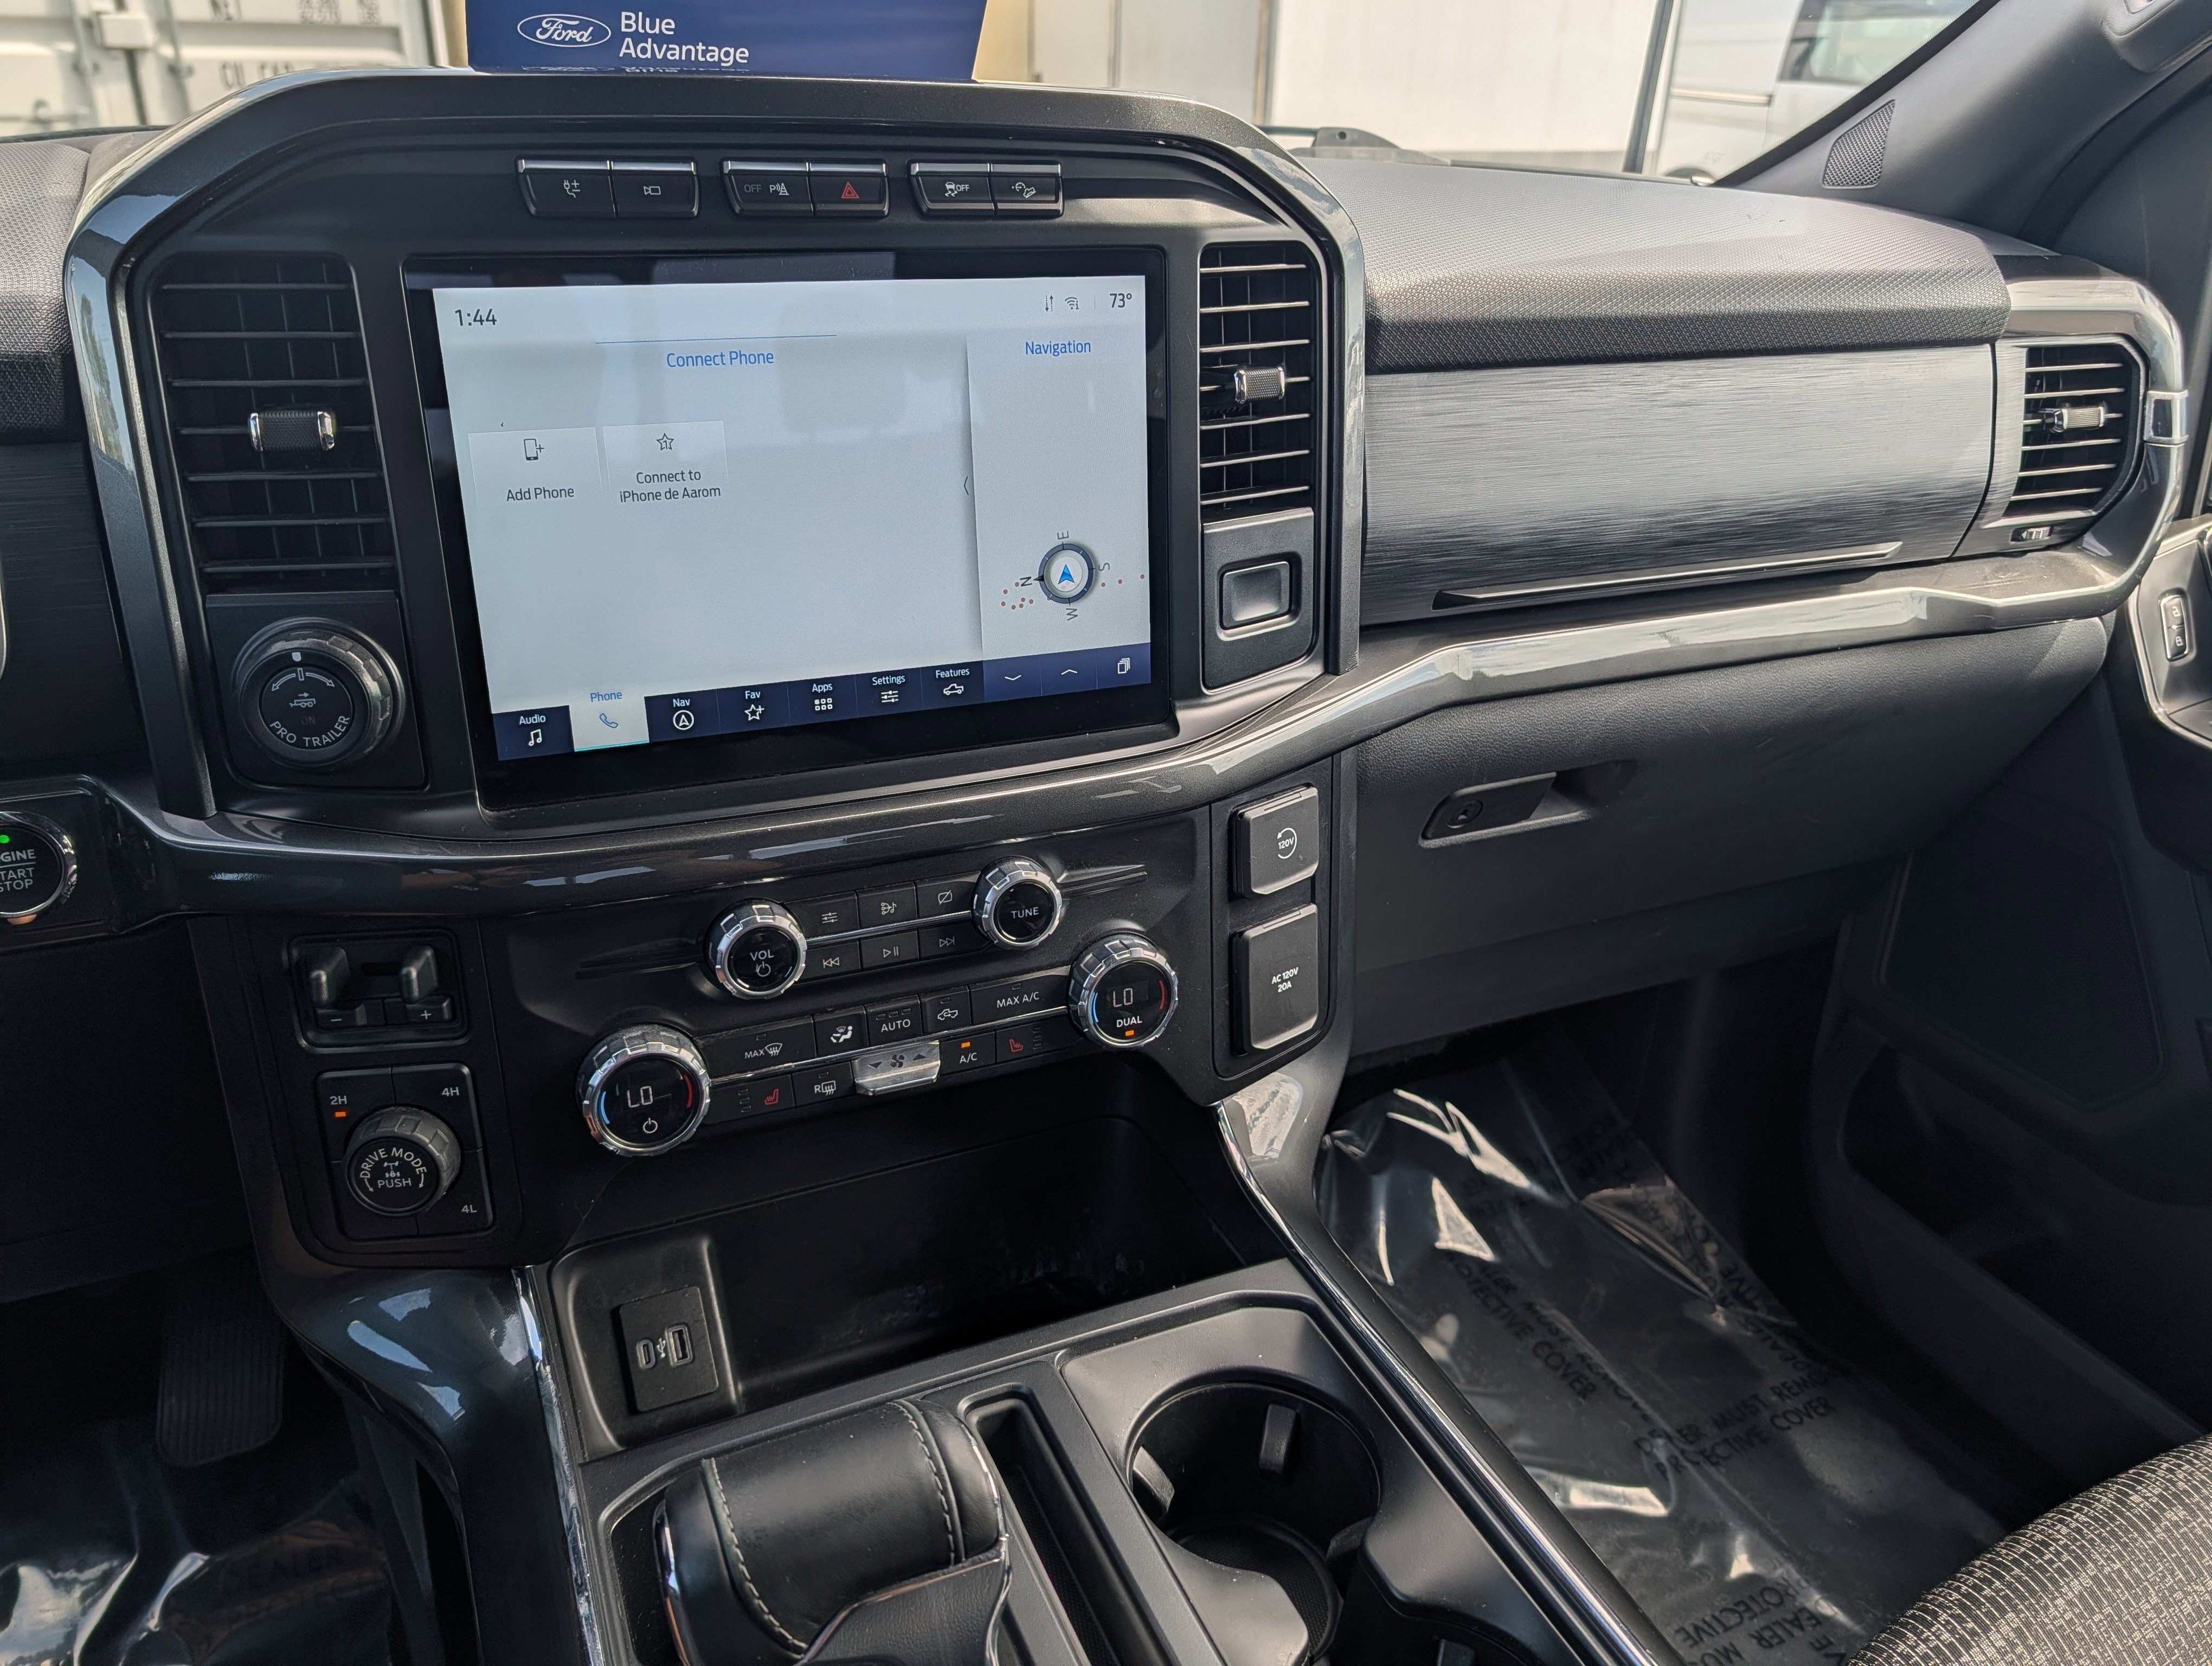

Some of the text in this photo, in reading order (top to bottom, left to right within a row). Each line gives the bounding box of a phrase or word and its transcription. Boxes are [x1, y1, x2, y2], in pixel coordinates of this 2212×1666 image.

[536, 17, 594, 42] Ford
[620, 11, 676, 35] Blue
[619, 37, 749, 67] Advantage
[743, 184, 762, 193] OFF
[956, 184, 970, 192] OFF
[454, 308, 498, 326] 1:44
[1025, 339, 1092, 357] Navigation
[666, 350, 774, 369] Connect Phone
[635, 469, 702, 484] Connect to
[506, 485, 575, 502] Add Phone
[619, 485, 722, 503] iPhone de Aarom
[1057, 530, 1070, 541] E
[1097, 562, 1110, 572] S
[1019, 575, 1033, 587] N
[1065, 607, 1079, 621] W
[871, 673, 906, 687] Settings
[935, 667, 970, 680] Features
[744, 689, 762, 700] Fav
[812, 682, 833, 694] Apps
[589, 690, 623, 703] Phone
[672, 697, 691, 708] Nav
[518, 713, 546, 726] Audio
[270, 715, 351, 748] PRO TRAILER
[1277, 836, 1295, 850] 120V
[0, 849, 37, 863] GINE
[0, 867, 35, 881] TART
[1010, 906, 1040, 919] TUNE
[749, 949, 775, 962] VOL
[1271, 966, 1299, 985] AC 120V
[1277, 981, 1293, 994] 20A
[996, 991, 1040, 1009] MAX A/C
[880, 1018, 911, 1033] AUTO
[1116, 1015, 1143, 1028] DUAL
[744, 1047, 766, 1060] MAX
[959, 1052, 978, 1065] A/C
[441, 1086, 460, 1098] 4H
[329, 1095, 348, 1105] 2H
[359, 1146, 428, 1179] DRIVE MODE
[377, 1177, 413, 1189] PUSH
[461, 1204, 478, 1214] 4L
[1532, 1340, 1597, 1400] COVER
[1769, 1395, 1836, 1432] COVER
